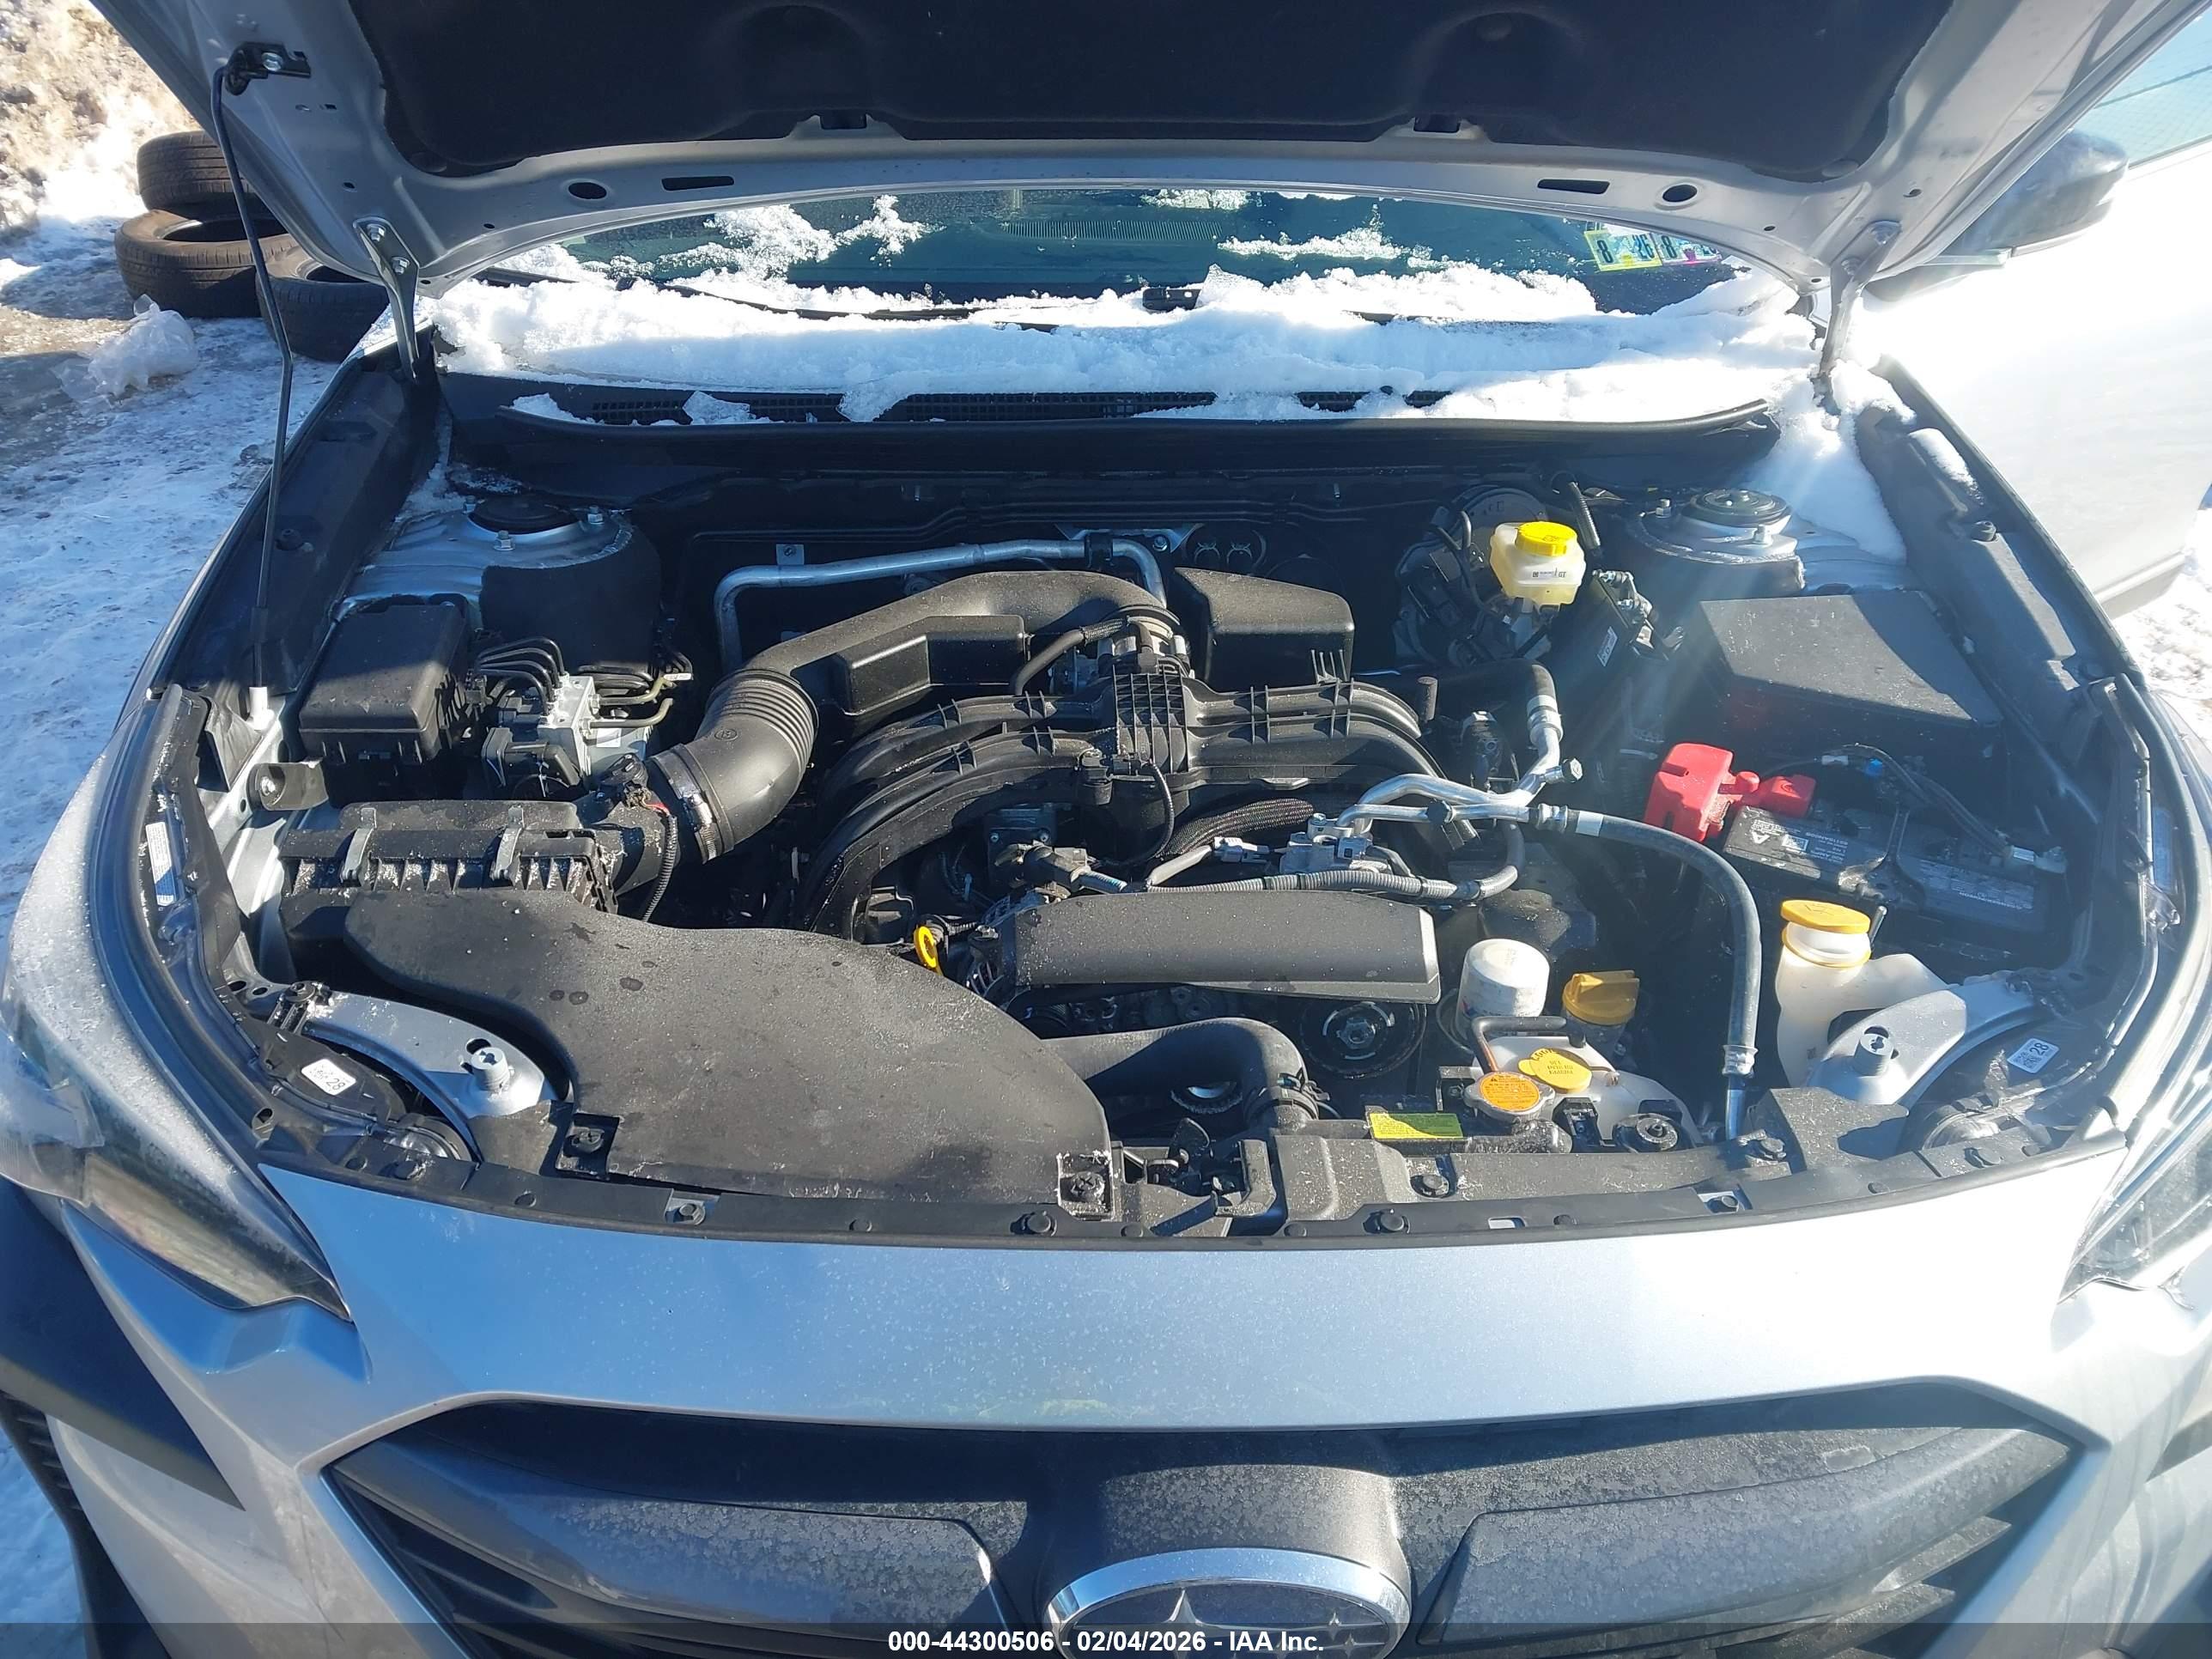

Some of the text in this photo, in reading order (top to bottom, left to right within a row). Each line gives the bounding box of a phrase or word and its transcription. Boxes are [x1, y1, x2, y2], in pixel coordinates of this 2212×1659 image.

[1596, 233, 1655, 264] 8 26
[1660, 235, 1678, 258] 8
[2029, 1042, 2049, 1056] 28
[325, 1078, 346, 1091] 28
